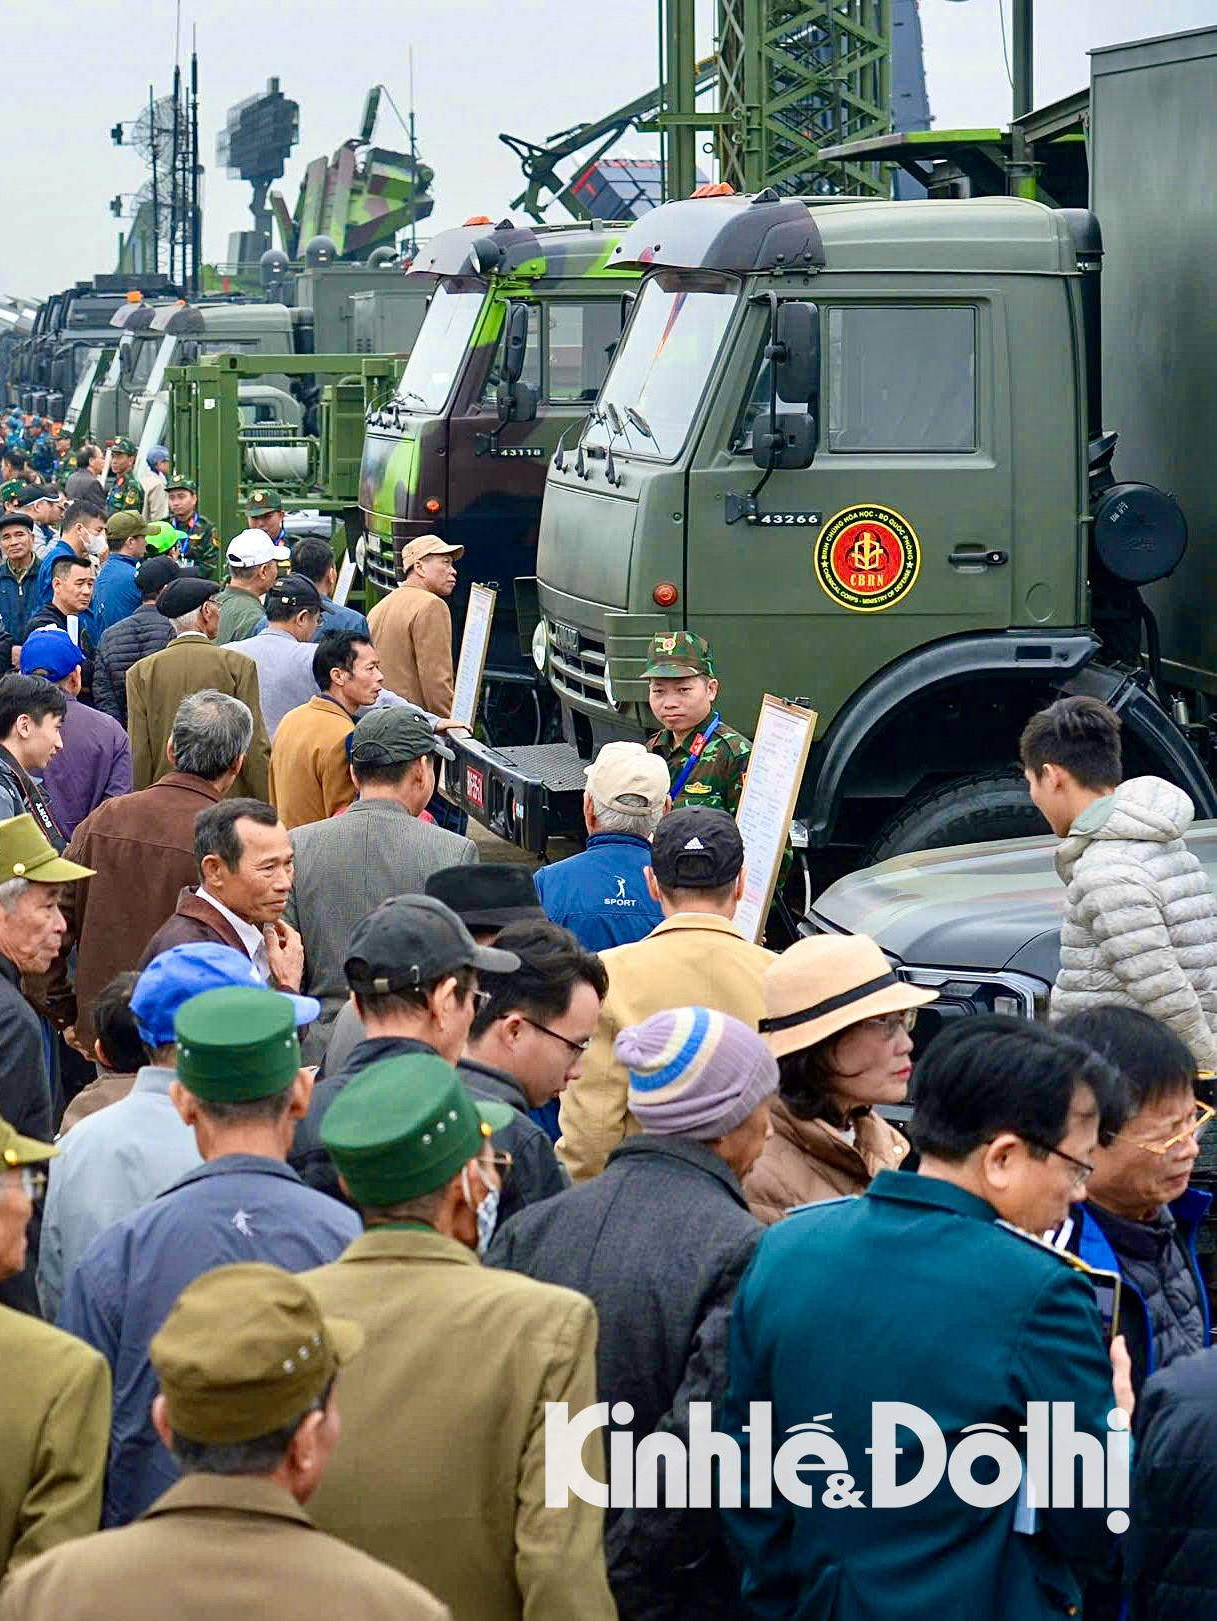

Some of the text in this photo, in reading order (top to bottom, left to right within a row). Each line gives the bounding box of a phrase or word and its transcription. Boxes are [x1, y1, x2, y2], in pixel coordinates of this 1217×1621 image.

[760, 514, 818, 524] 43266
[821, 542, 830, 560] BINH
[823, 568, 859, 604] CHEMICAL CORPS
[850, 574, 884, 587] CBRN
[862, 594, 887, 604] MINISTRY
[887, 590, 894, 598] OF
[36, 803, 52, 828] SONY
[604, 898, 637, 907] SPORT
